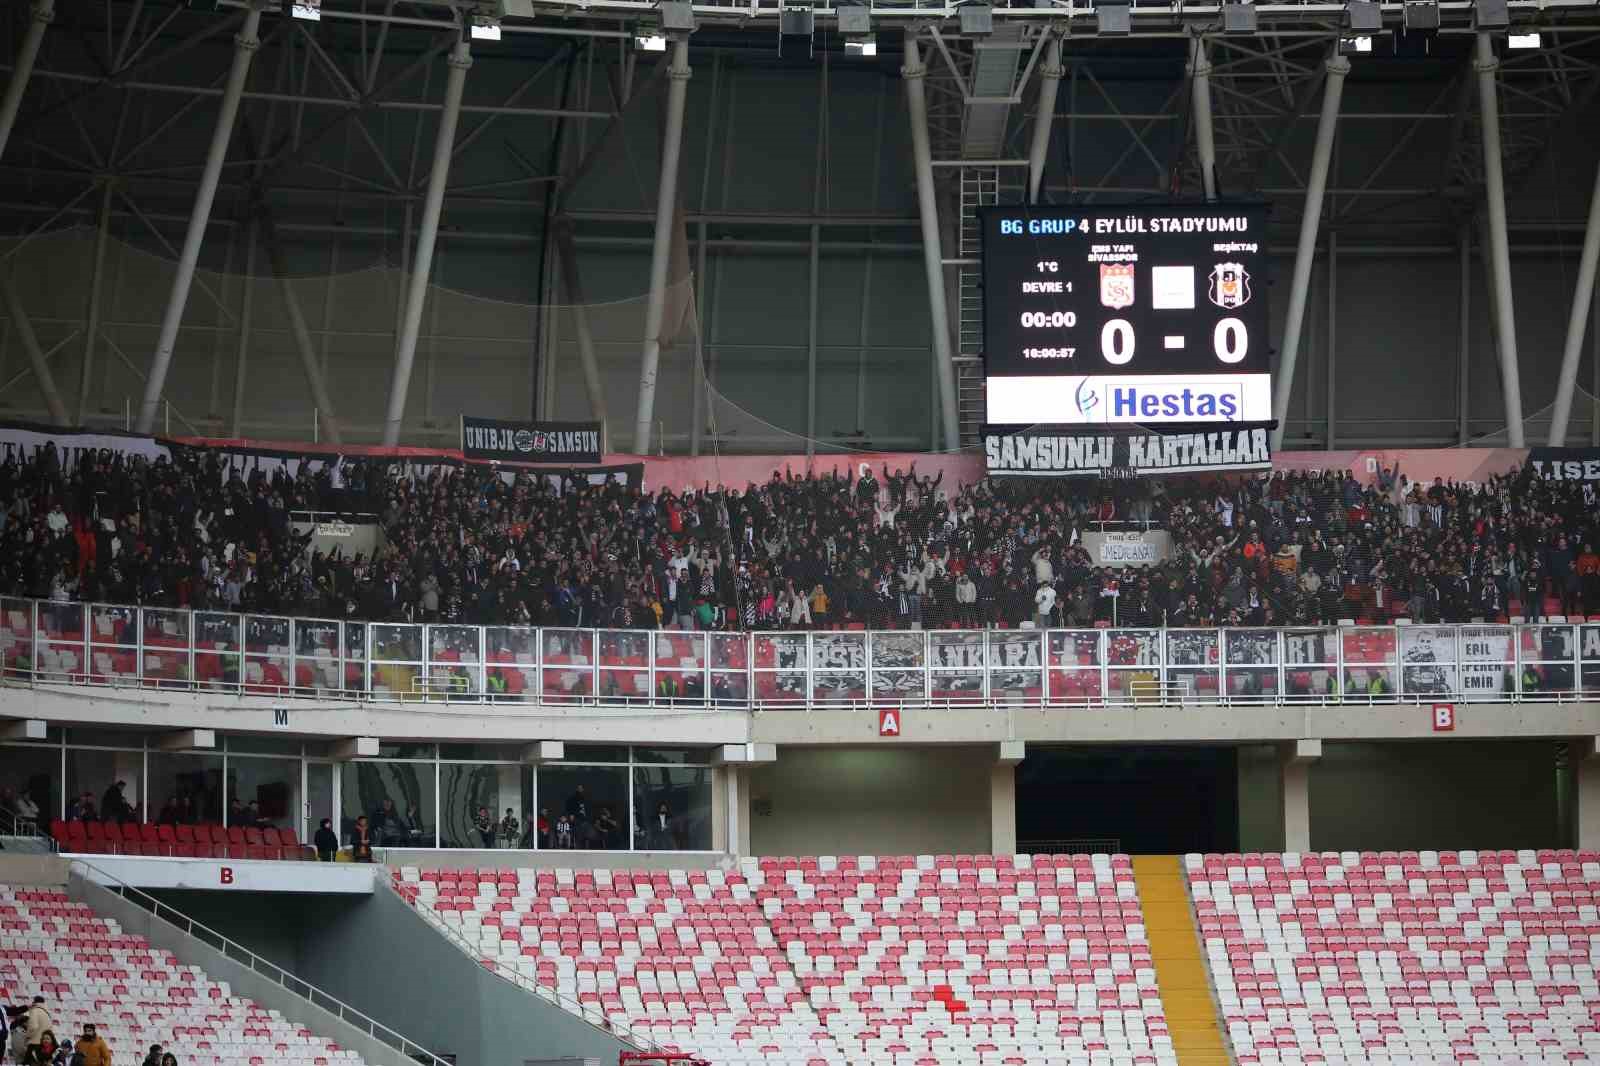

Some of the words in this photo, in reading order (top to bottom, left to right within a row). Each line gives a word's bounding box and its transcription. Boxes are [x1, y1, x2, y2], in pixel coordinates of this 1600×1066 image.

[1001, 219, 1022, 234] BG
[1029, 219, 1076, 234] GRUP
[1078, 218, 1089, 233] 4
[1095, 215, 1147, 233] EYLÜL
[1151, 217, 1248, 232] STADYUMU
[1022, 282, 1063, 293] DEVRE
[1066, 282, 1073, 293] 1
[1021, 312, 1077, 328] 00:00
[1101, 319, 1135, 365] 0
[1213, 317, 1248, 363] 0
[1114, 388, 1237, 421] Hestaş
[549, 431, 598, 453] SAMSUN
[985, 435, 1115, 469] SAMSUNLU
[1127, 427, 1269, 467] KARTALLAR
[929, 640, 1040, 675] ANKARA
[274, 708, 288, 726] M
[881, 712, 898, 733] A
[1435, 707, 1452, 726] B
[220, 867, 234, 884] B
